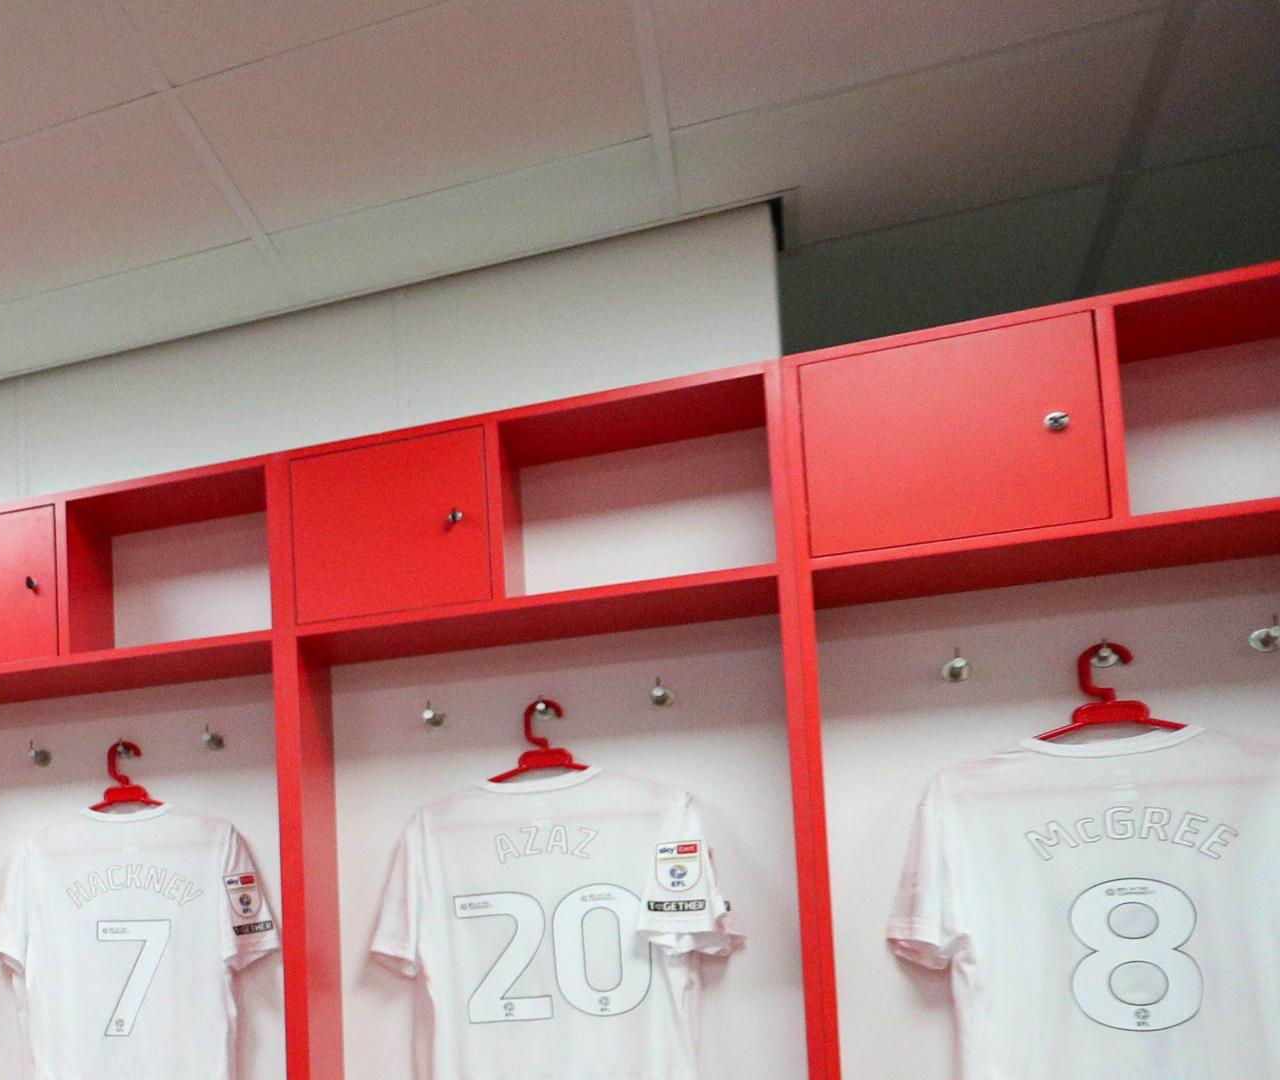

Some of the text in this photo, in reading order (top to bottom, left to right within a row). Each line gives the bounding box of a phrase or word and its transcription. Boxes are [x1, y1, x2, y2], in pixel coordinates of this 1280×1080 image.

[495, 824, 599, 864] AZAZ
[1024, 806, 1240, 861] McGREE
[66, 864, 204, 909] HACKNEY
[96, 918, 172, 1037] 7
[453, 881, 653, 1024] 20
[1067, 877, 1204, 1032] 8
